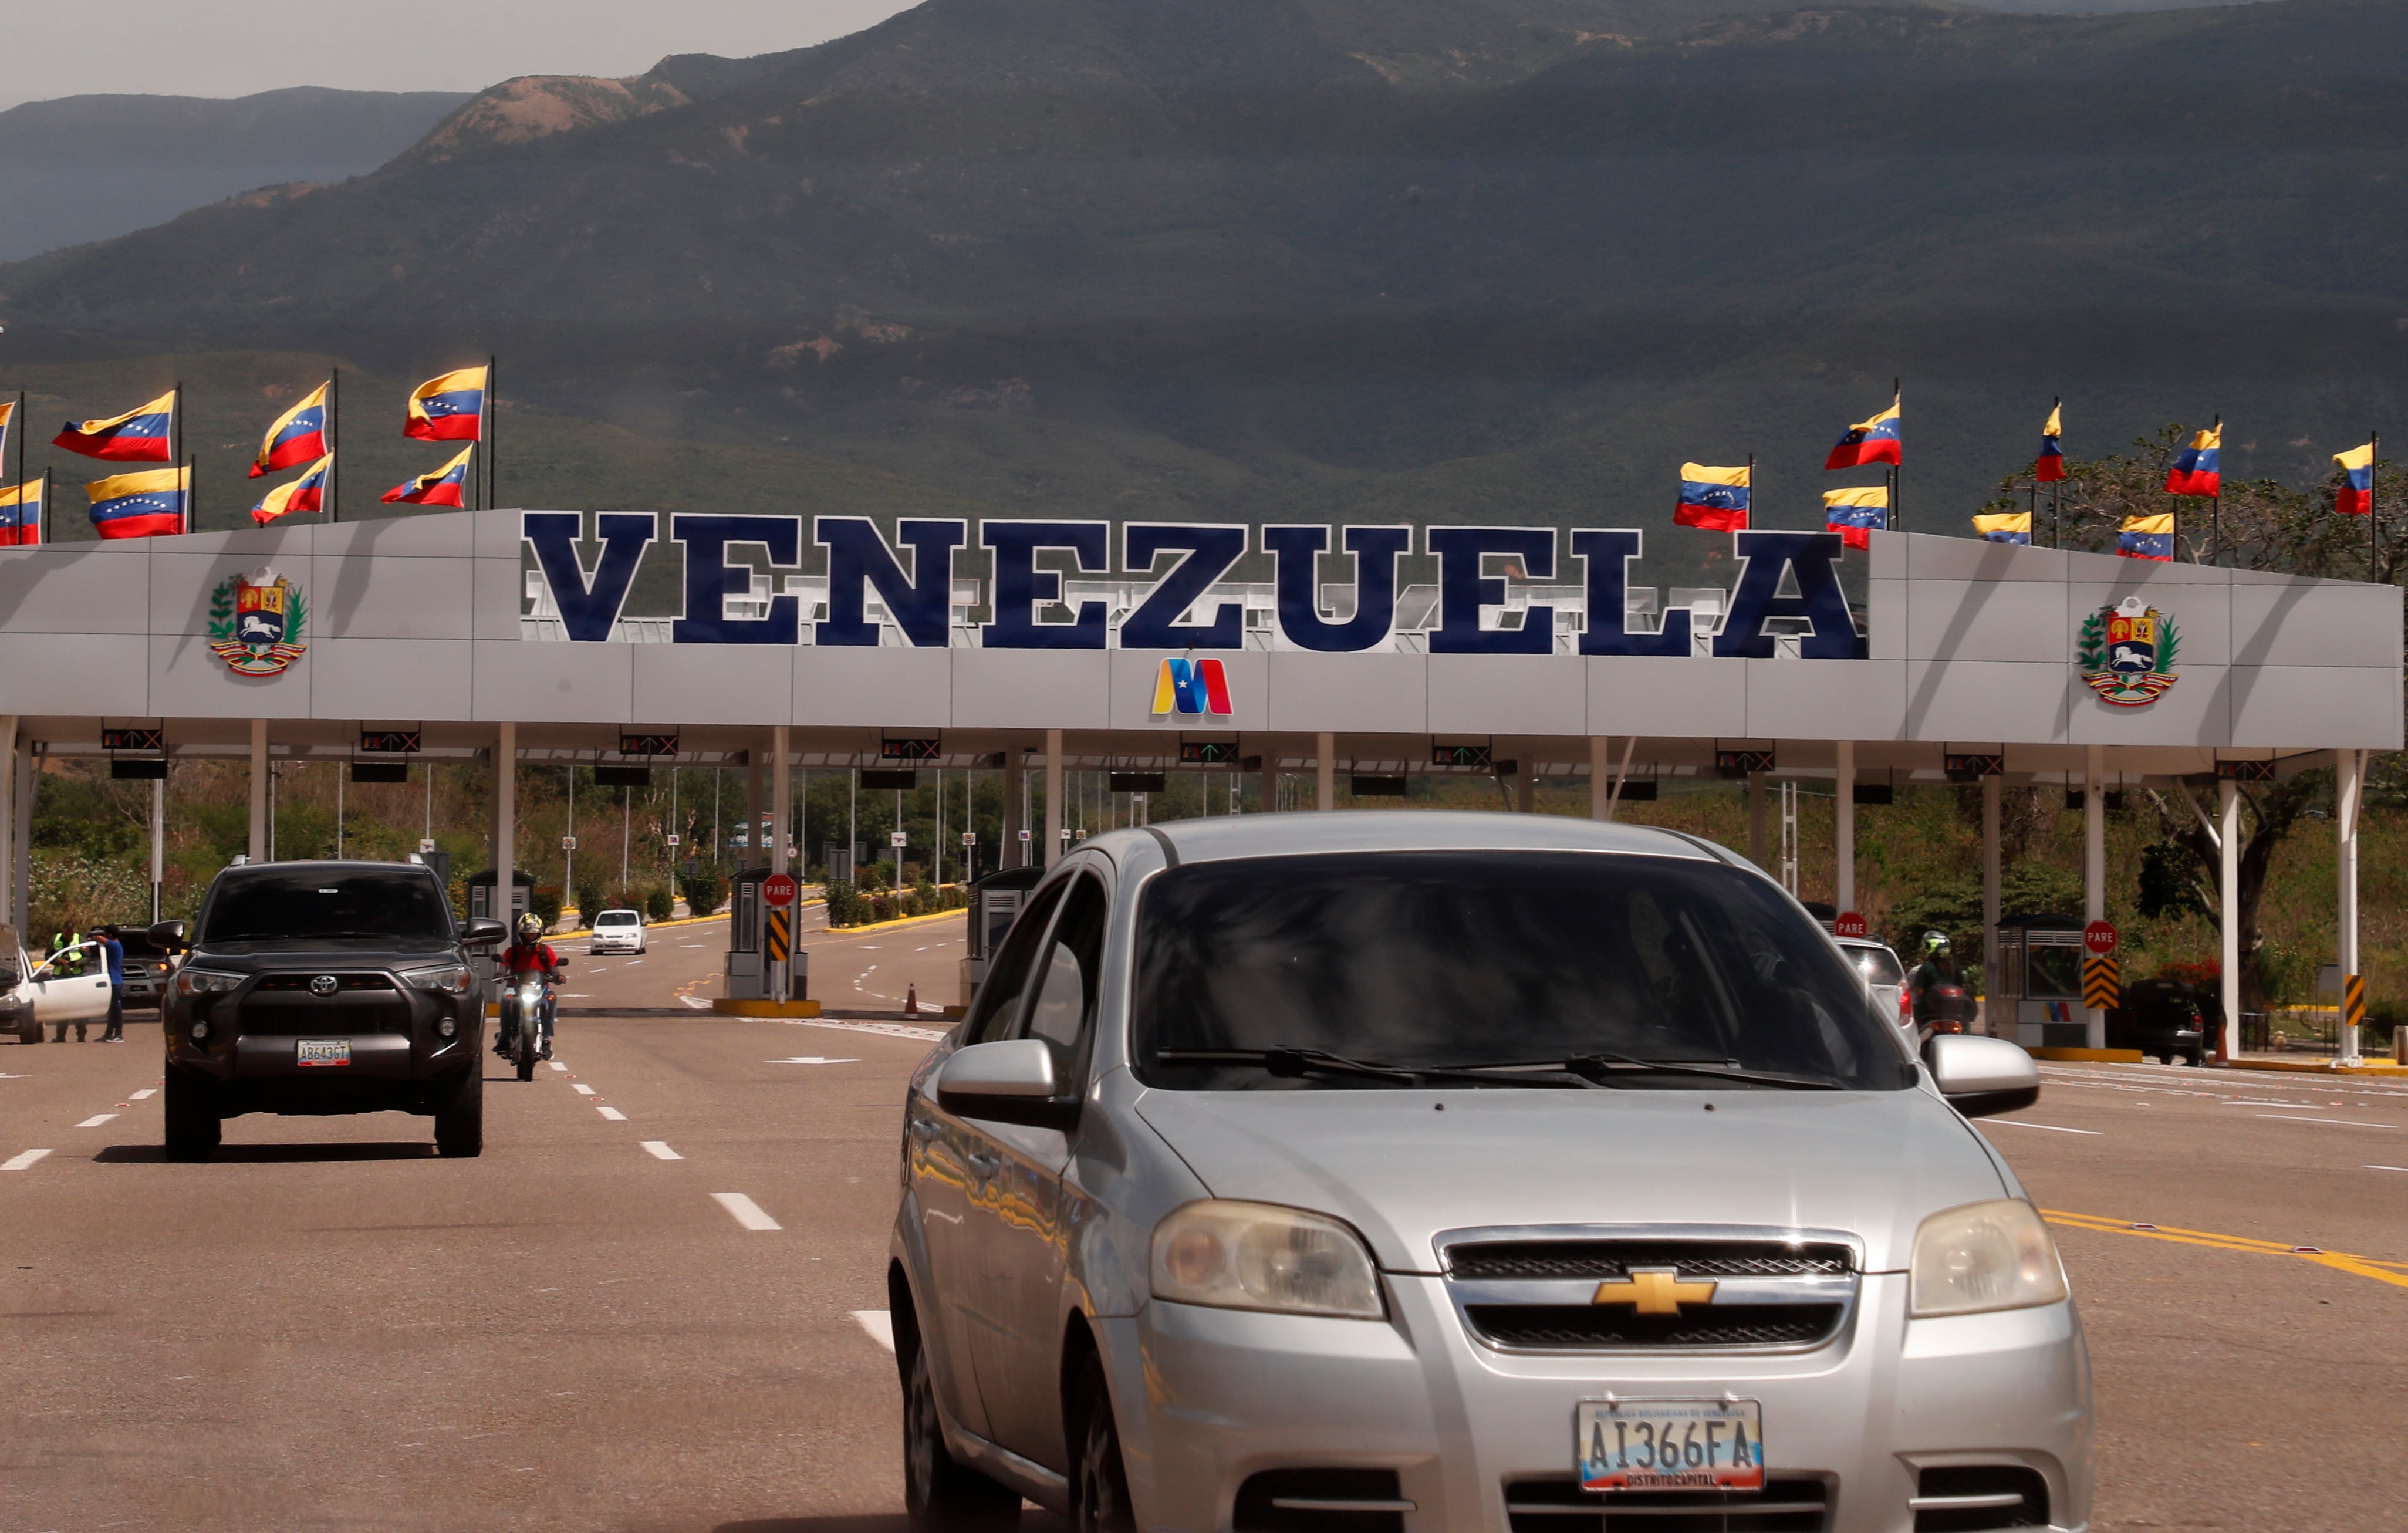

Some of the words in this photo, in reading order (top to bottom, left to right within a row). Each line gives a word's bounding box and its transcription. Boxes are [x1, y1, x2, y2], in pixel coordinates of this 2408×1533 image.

[521, 510, 1869, 659] VENEZUELA
[766, 885, 792, 896] PARE
[1838, 923, 1864, 934] PARE
[2088, 932, 2113, 943] PARE
[301, 1046, 346, 1060] AB643GT
[1590, 1419, 1753, 1468] AI366FA
